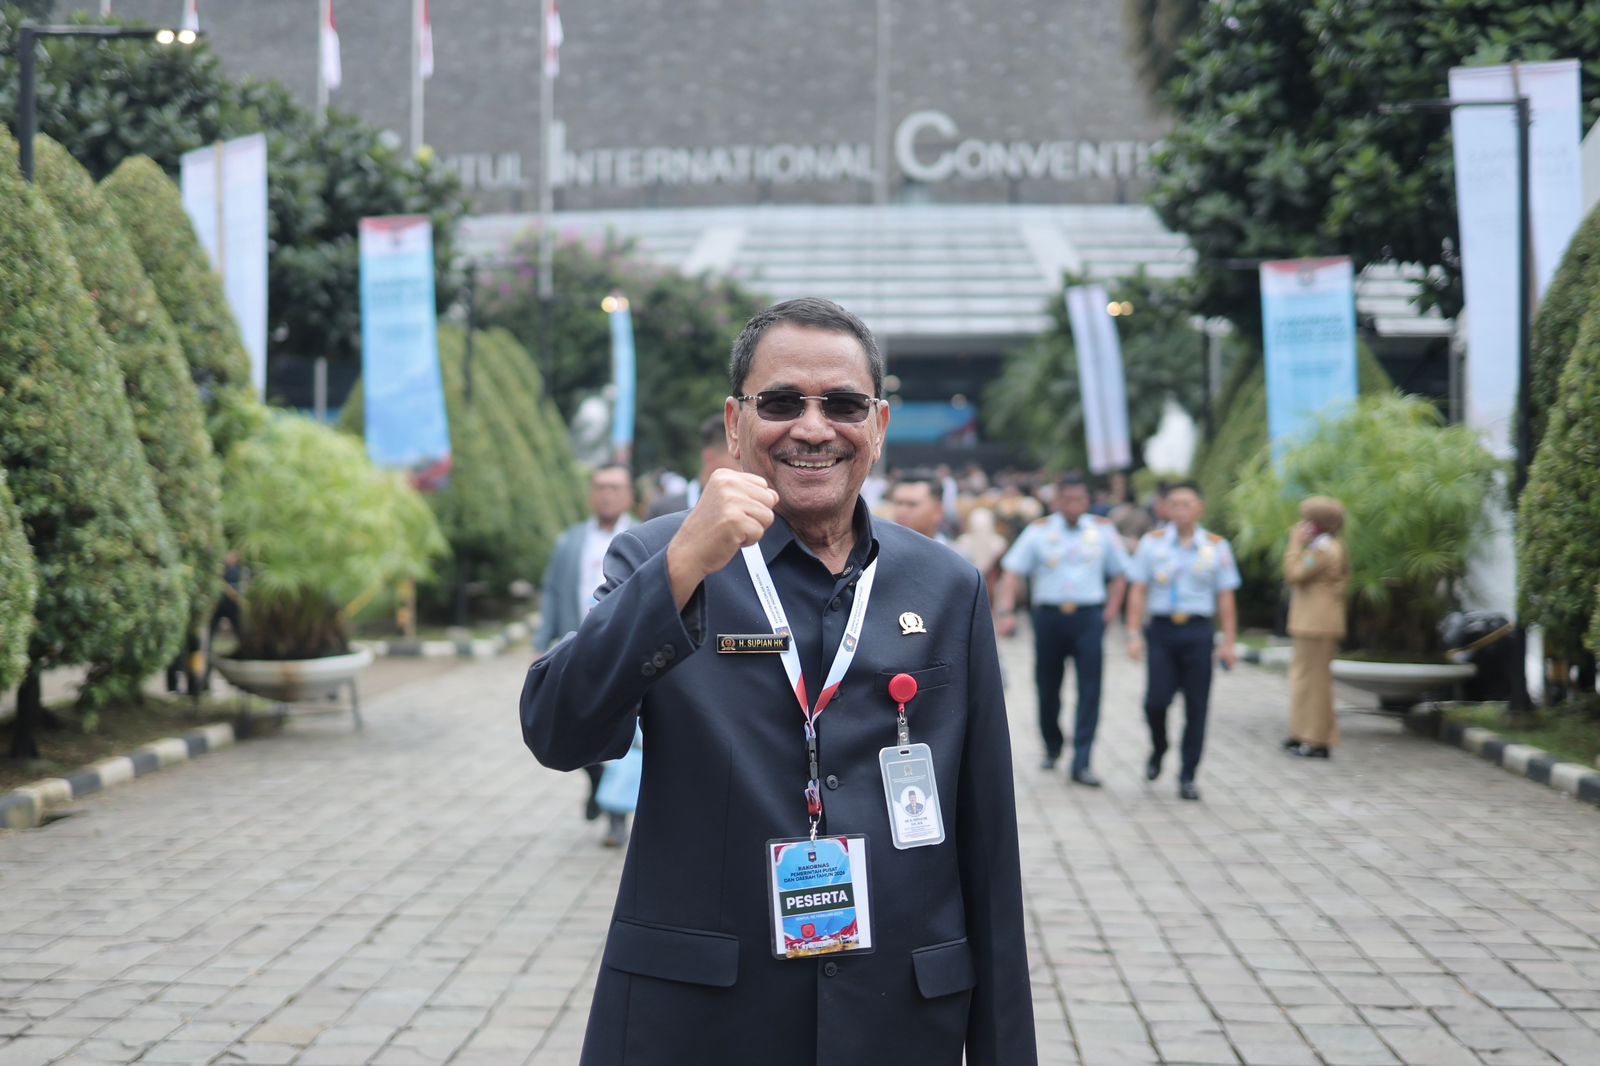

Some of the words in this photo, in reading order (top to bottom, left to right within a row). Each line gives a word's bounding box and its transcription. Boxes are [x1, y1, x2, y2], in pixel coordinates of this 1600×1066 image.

[739, 639, 746, 647] H.
[747, 639, 773, 648] SUPIAN
[773, 639, 784, 647] HK
[798, 863, 830, 871] RAKORNAS
[790, 869, 822, 877] PEMERINTAH
[786, 889, 849, 910] PESERTA
